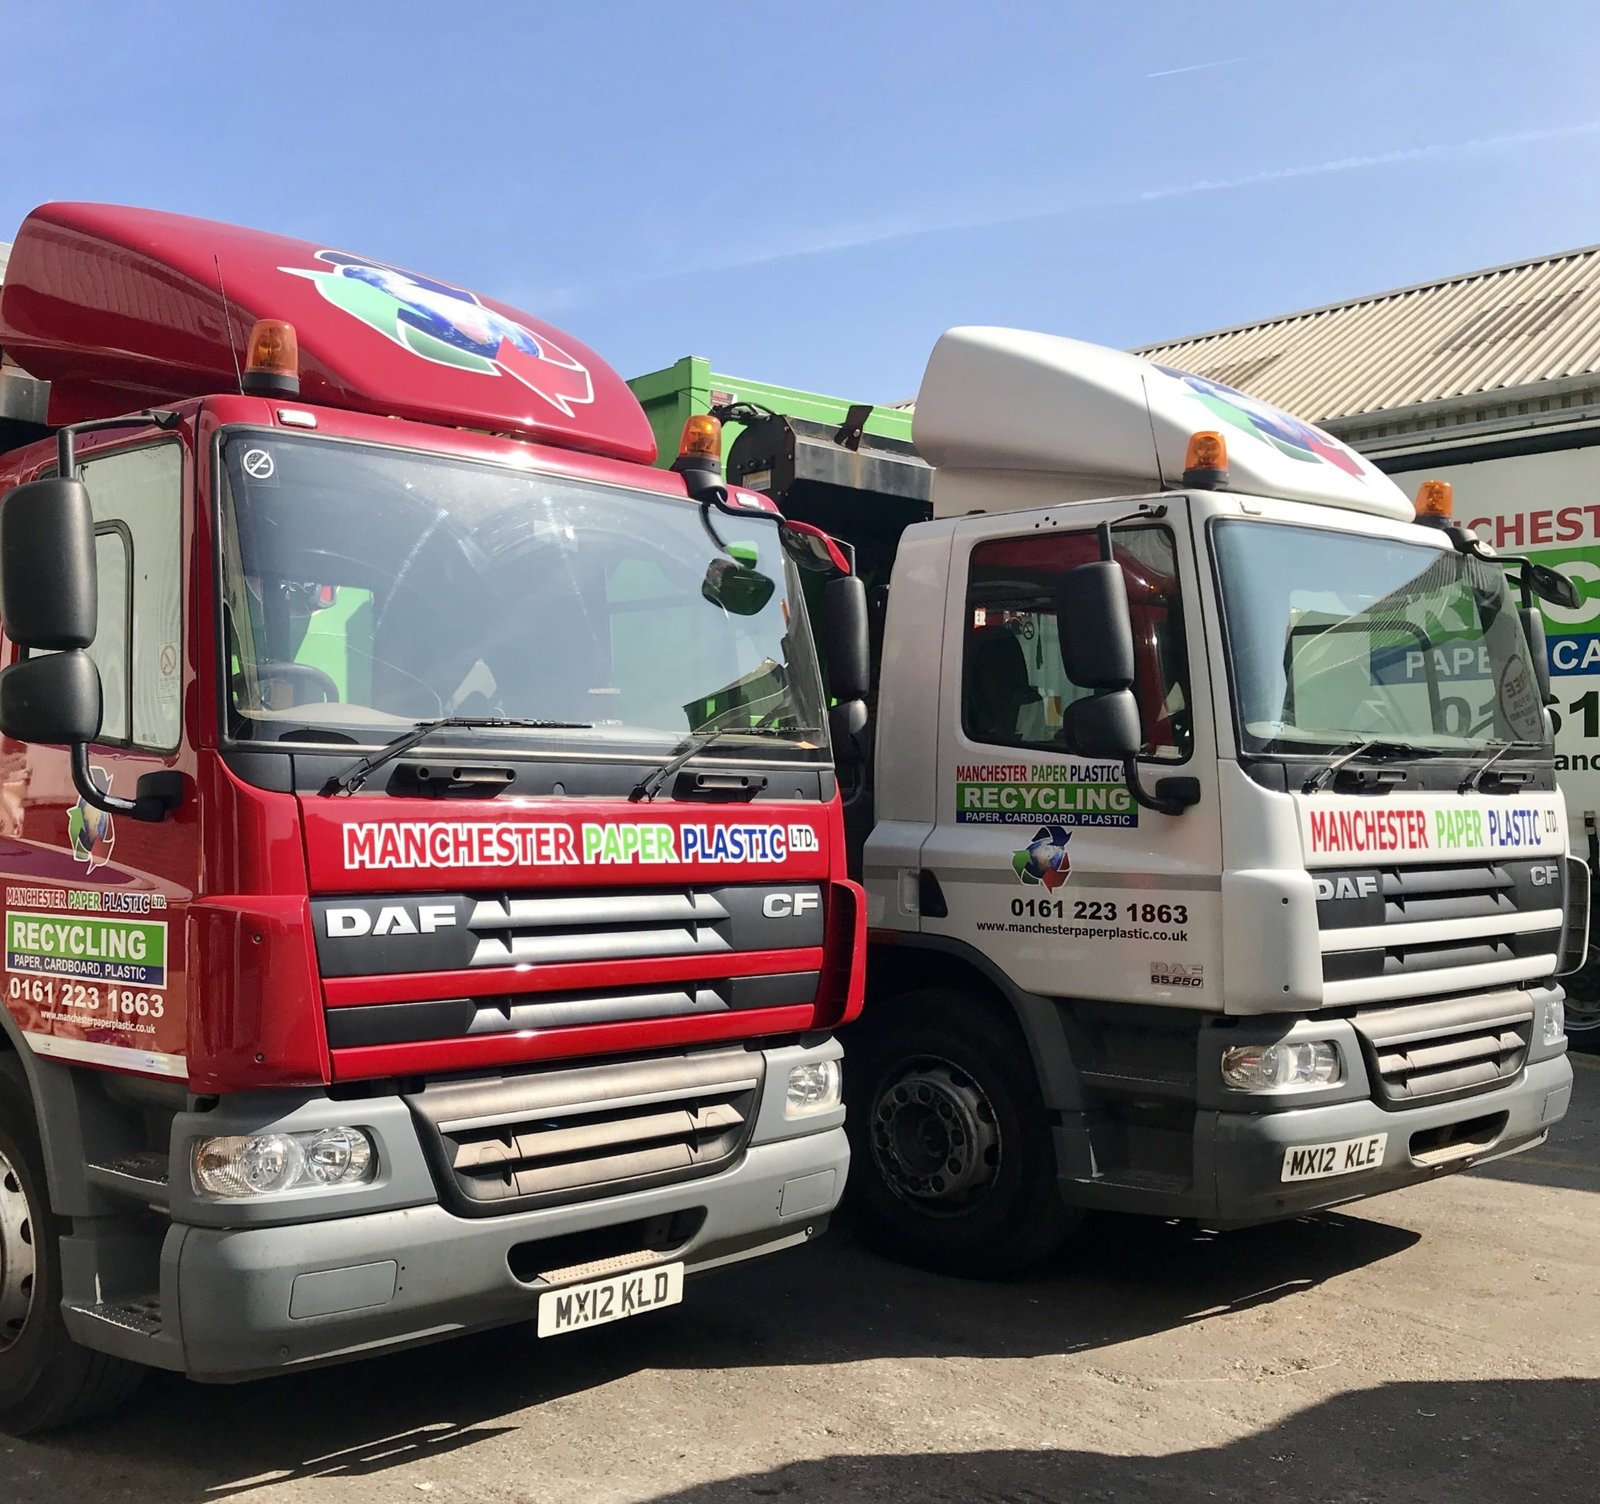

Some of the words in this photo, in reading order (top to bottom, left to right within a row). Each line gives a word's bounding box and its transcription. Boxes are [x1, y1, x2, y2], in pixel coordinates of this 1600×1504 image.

[1453, 505, 1600, 549] CHEST
[956, 764, 1027, 782] MANCHESTER
[1031, 765, 1067, 782] PAPER
[1070, 765, 1119, 782] PLASTIC
[964, 787, 1130, 811] RECYCLING
[966, 812, 1003, 824] PAPER,
[1005, 813, 1078, 826] CARDBOARD,
[1081, 814, 1130, 826] PLASTIC
[1310, 809, 1429, 852] MANCHESTER
[1435, 809, 1484, 848] PAPER
[1488, 809, 1541, 846] PLASTIC
[343, 821, 579, 870] MANCHESTER
[583, 823, 680, 864] PAPER
[681, 822, 787, 863] PLASTIC
[789, 824, 819, 852] LTD.
[1315, 876, 1378, 900] DAF
[1531, 866, 1558, 886] CF
[6, 887, 67, 908] MANCHESTER
[68, 890, 101, 911] PAPER
[103, 892, 149, 914] PLASTIC
[151, 894, 167, 909] LTD.
[761, 893, 818, 919] CF
[1011, 898, 1064, 919] 0161
[1073, 901, 1117, 921] 223
[1126, 903, 1188, 925] 1863
[326, 905, 456, 937] DAF
[976, 921, 1188, 942] www.manchesterpaperplastic.co.uk
[13, 921, 146, 960] RECYCLING
[14, 954, 42, 971] PAPER,
[44, 957, 103, 977] CARDBOARD,
[105, 965, 146, 980] PLASTIC
[1151, 975, 1202, 987] 65.250
[10, 977, 53, 1004] 0161
[62, 984, 99, 1009] 223
[108, 990, 164, 1018] 1863
[41, 1011, 155, 1034] www.manchesterpaperplastic.co.uk
[1290, 1147, 1336, 1176] MX12
[1345, 1139, 1379, 1169] KLE
[556, 1285, 614, 1328] MX12
[621, 1272, 668, 1312] KLD
